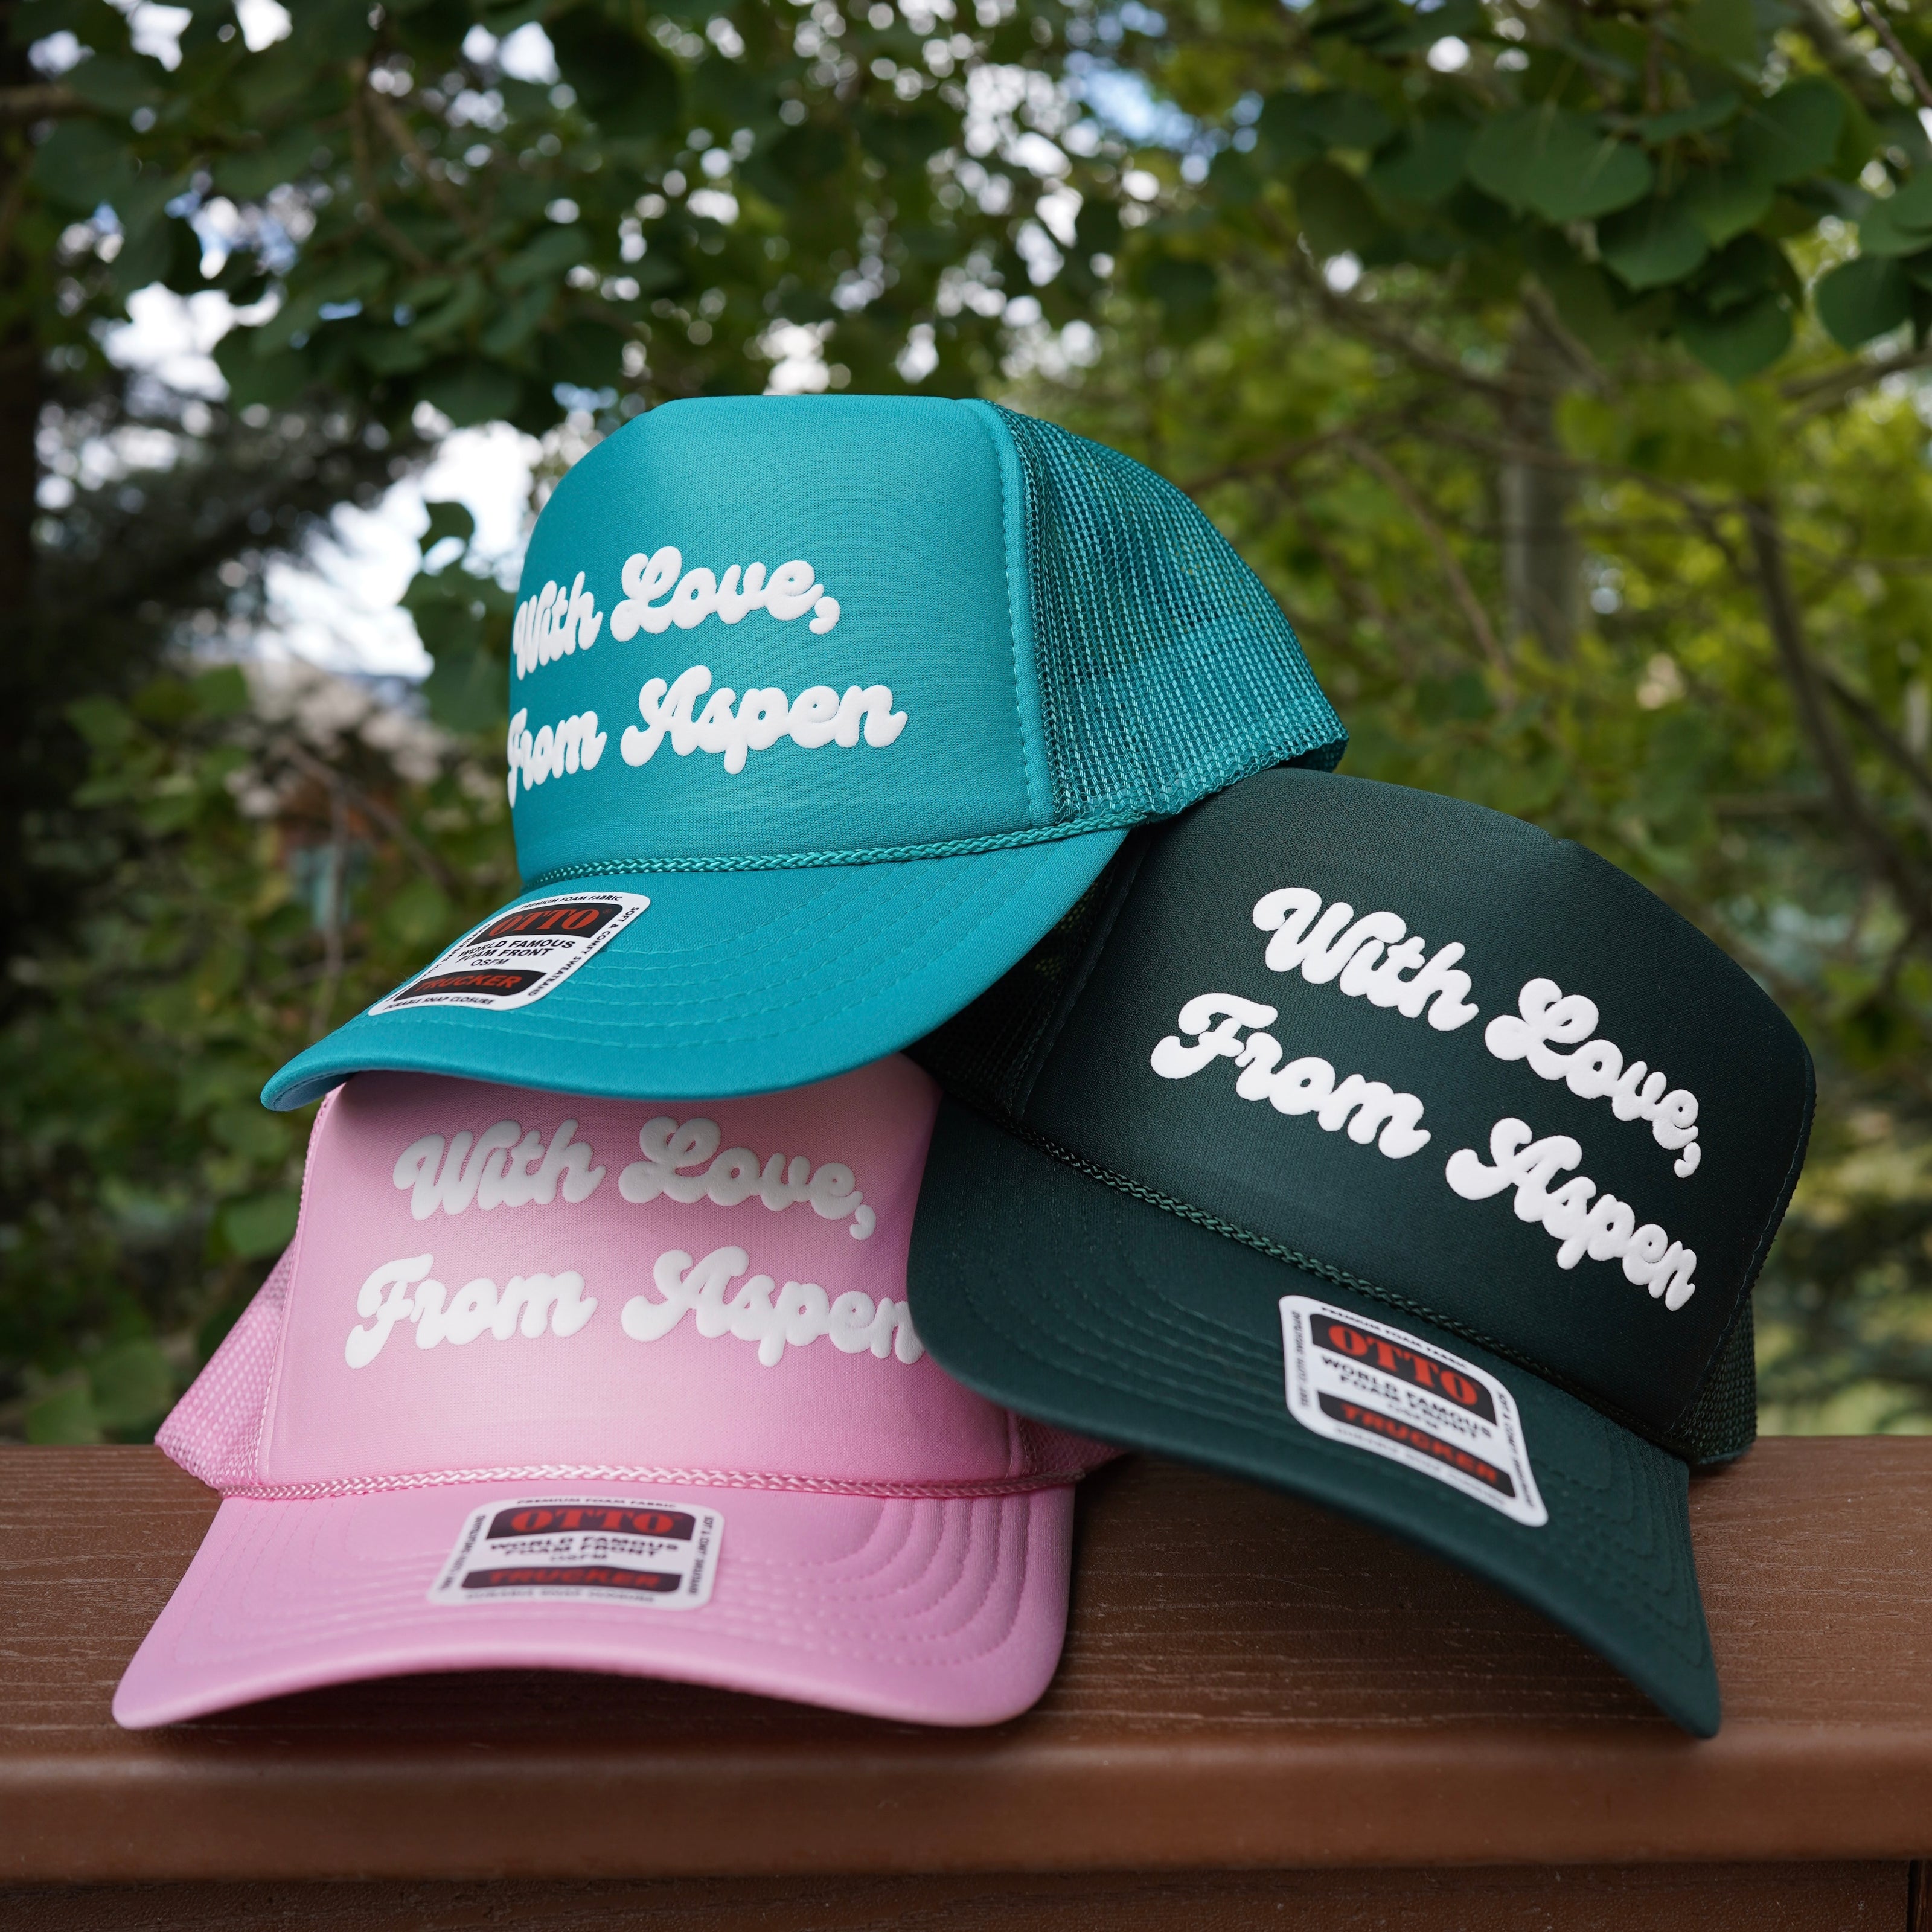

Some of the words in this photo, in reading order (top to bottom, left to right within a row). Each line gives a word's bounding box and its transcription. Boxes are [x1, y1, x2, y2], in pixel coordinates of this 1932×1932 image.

[513, 572, 603, 680] With
[610, 546, 840, 642] Love,
[507, 708, 607, 808] From
[621, 665, 908, 775] Aspen
[520, 898, 558, 910] PREMIUM
[618, 906, 639, 923] SOFT
[488, 908, 600, 936] OTTO
[455, 948, 497, 964] FOAM
[497, 948, 554, 957] FRONT
[458, 940, 508, 958] WORLD
[508, 939, 576, 948] FAMOUS
[581, 930, 610, 955] COMFY
[470, 958, 510, 967] OSFM
[414, 974, 522, 993] TRUCKER
[1252, 886, 1479, 1032] With
[1484, 977, 1701, 1179] Love,
[1150, 993, 1431, 1159] From
[1445, 1117, 1697, 1311] Aspen
[392, 1119, 606, 1221] With
[618, 1116, 877, 1241] Love,
[345, 1254, 598, 1369] From
[621, 1246, 924, 1367] Aspen
[1328, 1325, 1479, 1406] OTTO
[1322, 1355, 1398, 1393] WORLD
[1406, 1390, 1491, 1439] FAMOUS
[1340, 1375, 1401, 1403] FOAM
[1340, 1401, 1498, 1483] TRUCKER
[510, 1509, 674, 1535] OTTO
[490, 1537, 574, 1550] WORLD
[583, 1537, 679, 1550] FAMOUS
[489, 1569, 660, 1588] TRUCKER
